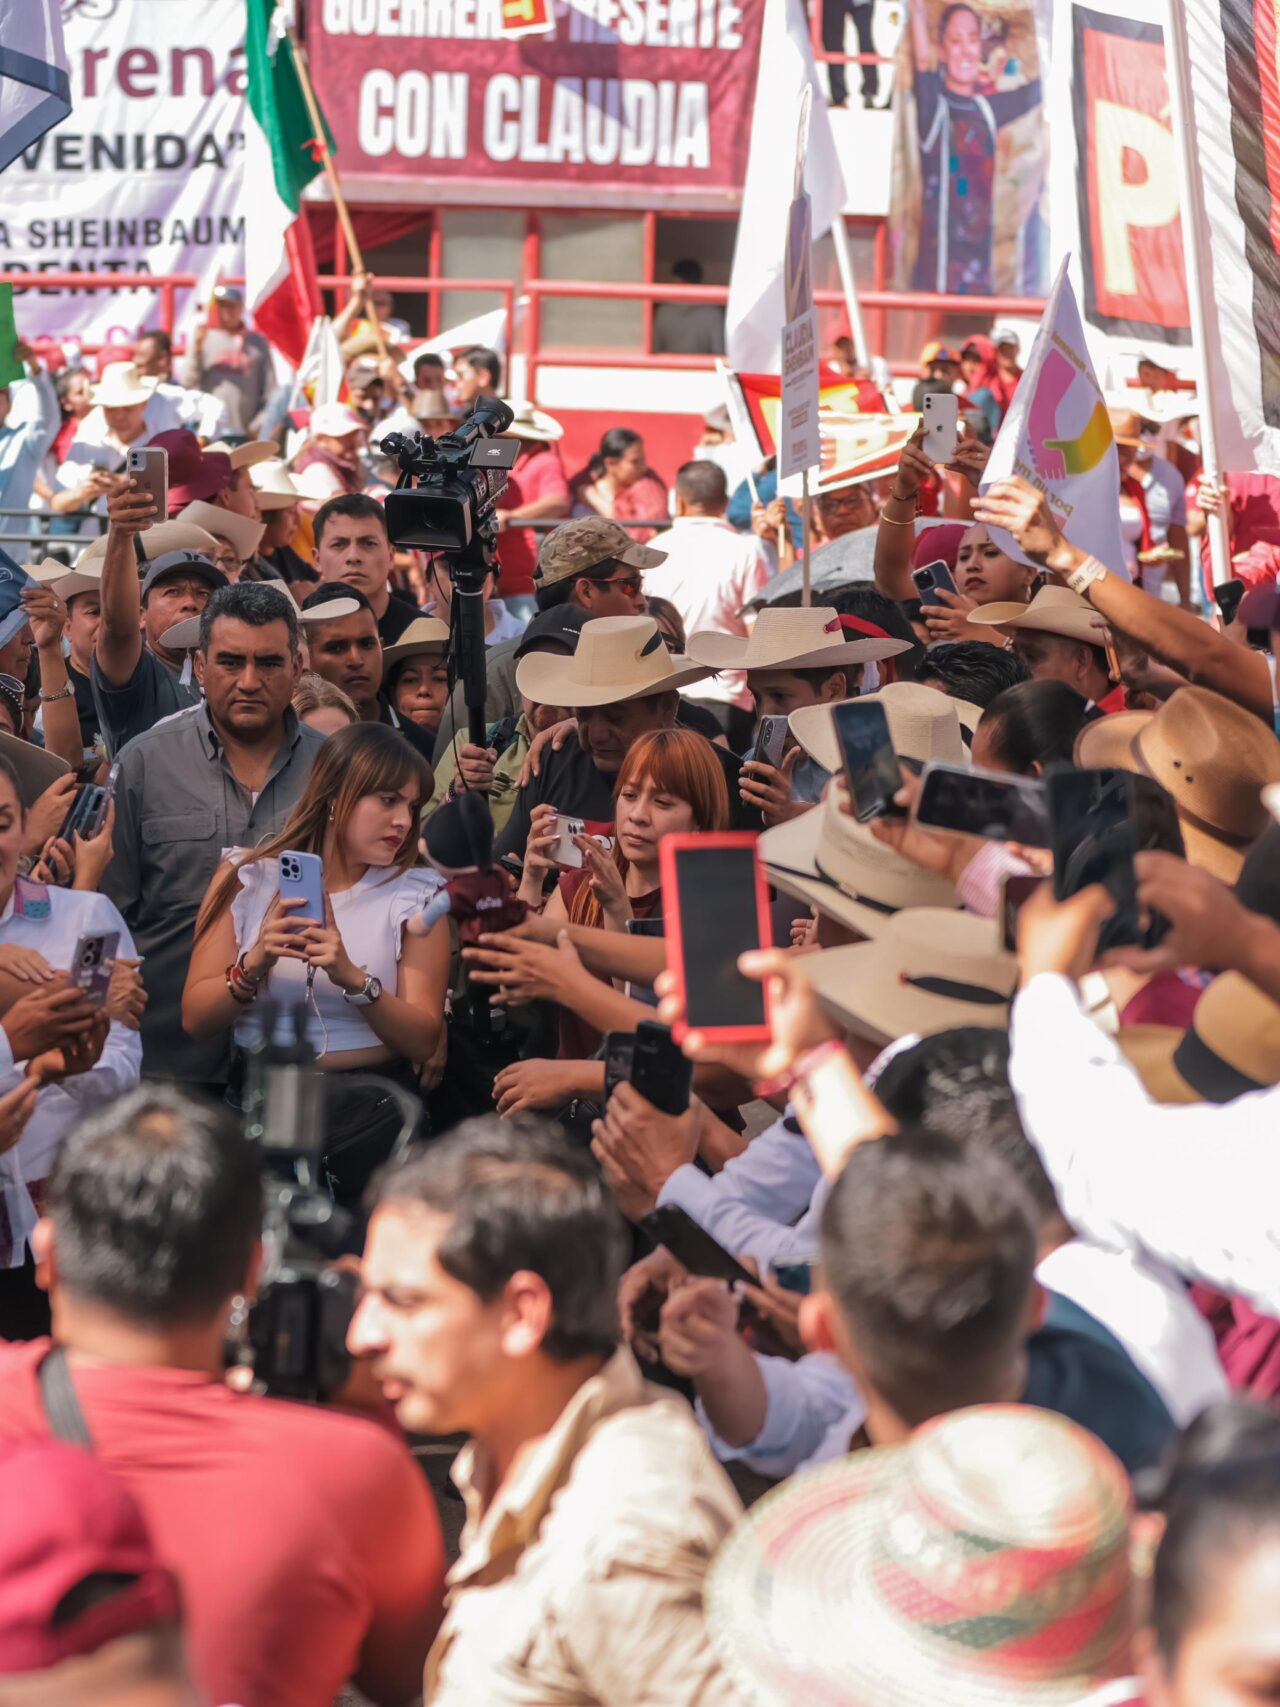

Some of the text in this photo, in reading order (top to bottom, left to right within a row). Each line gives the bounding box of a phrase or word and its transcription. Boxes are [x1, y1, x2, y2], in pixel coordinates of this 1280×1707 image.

[322, 0, 508, 40] GUERRER
[70, 47, 247, 99] rena
[358, 68, 710, 168] CON CLAUDIA
[34, 217, 246, 249] SHEINBAUM
